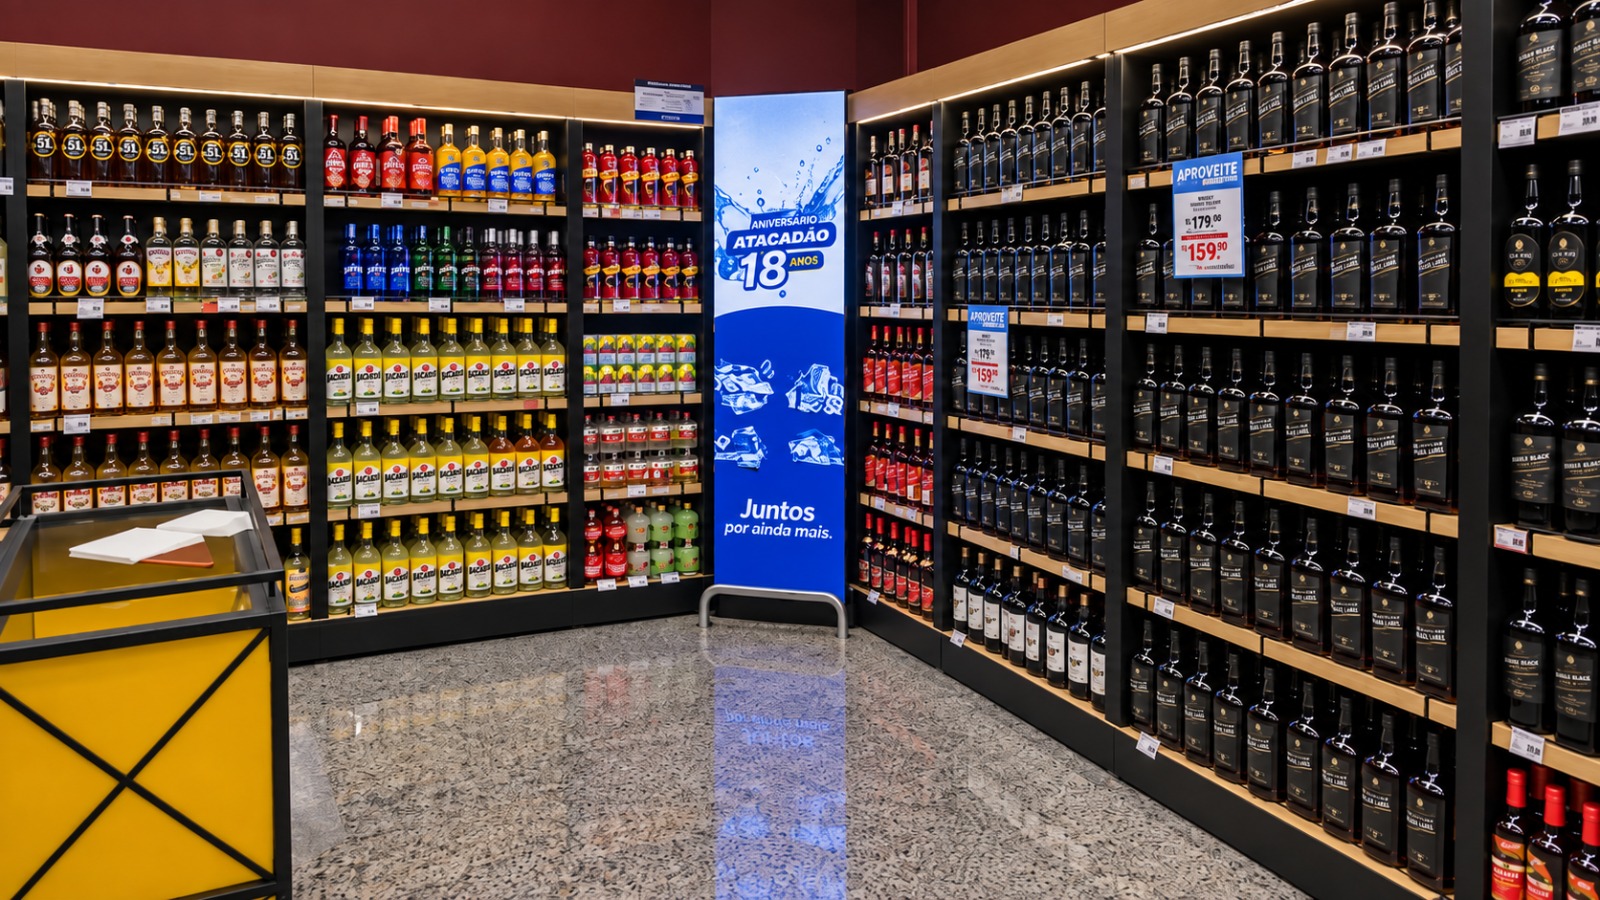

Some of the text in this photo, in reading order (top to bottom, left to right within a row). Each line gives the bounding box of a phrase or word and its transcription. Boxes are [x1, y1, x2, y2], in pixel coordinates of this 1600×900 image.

[37, 138, 52, 148] 51
[68, 140, 83, 150] 51
[96, 141, 111, 151] 51
[1177, 162, 1238, 182] APROVEITE
[751, 214, 817, 230] ANIVERSÁRIO
[733, 227, 830, 249] ATACADÃO
[740, 250, 818, 288] 18 ANOS
[970, 311, 1005, 323] APROVEITE
[740, 498, 815, 522] Juntos
[724, 522, 832, 539] por ainda mais.
